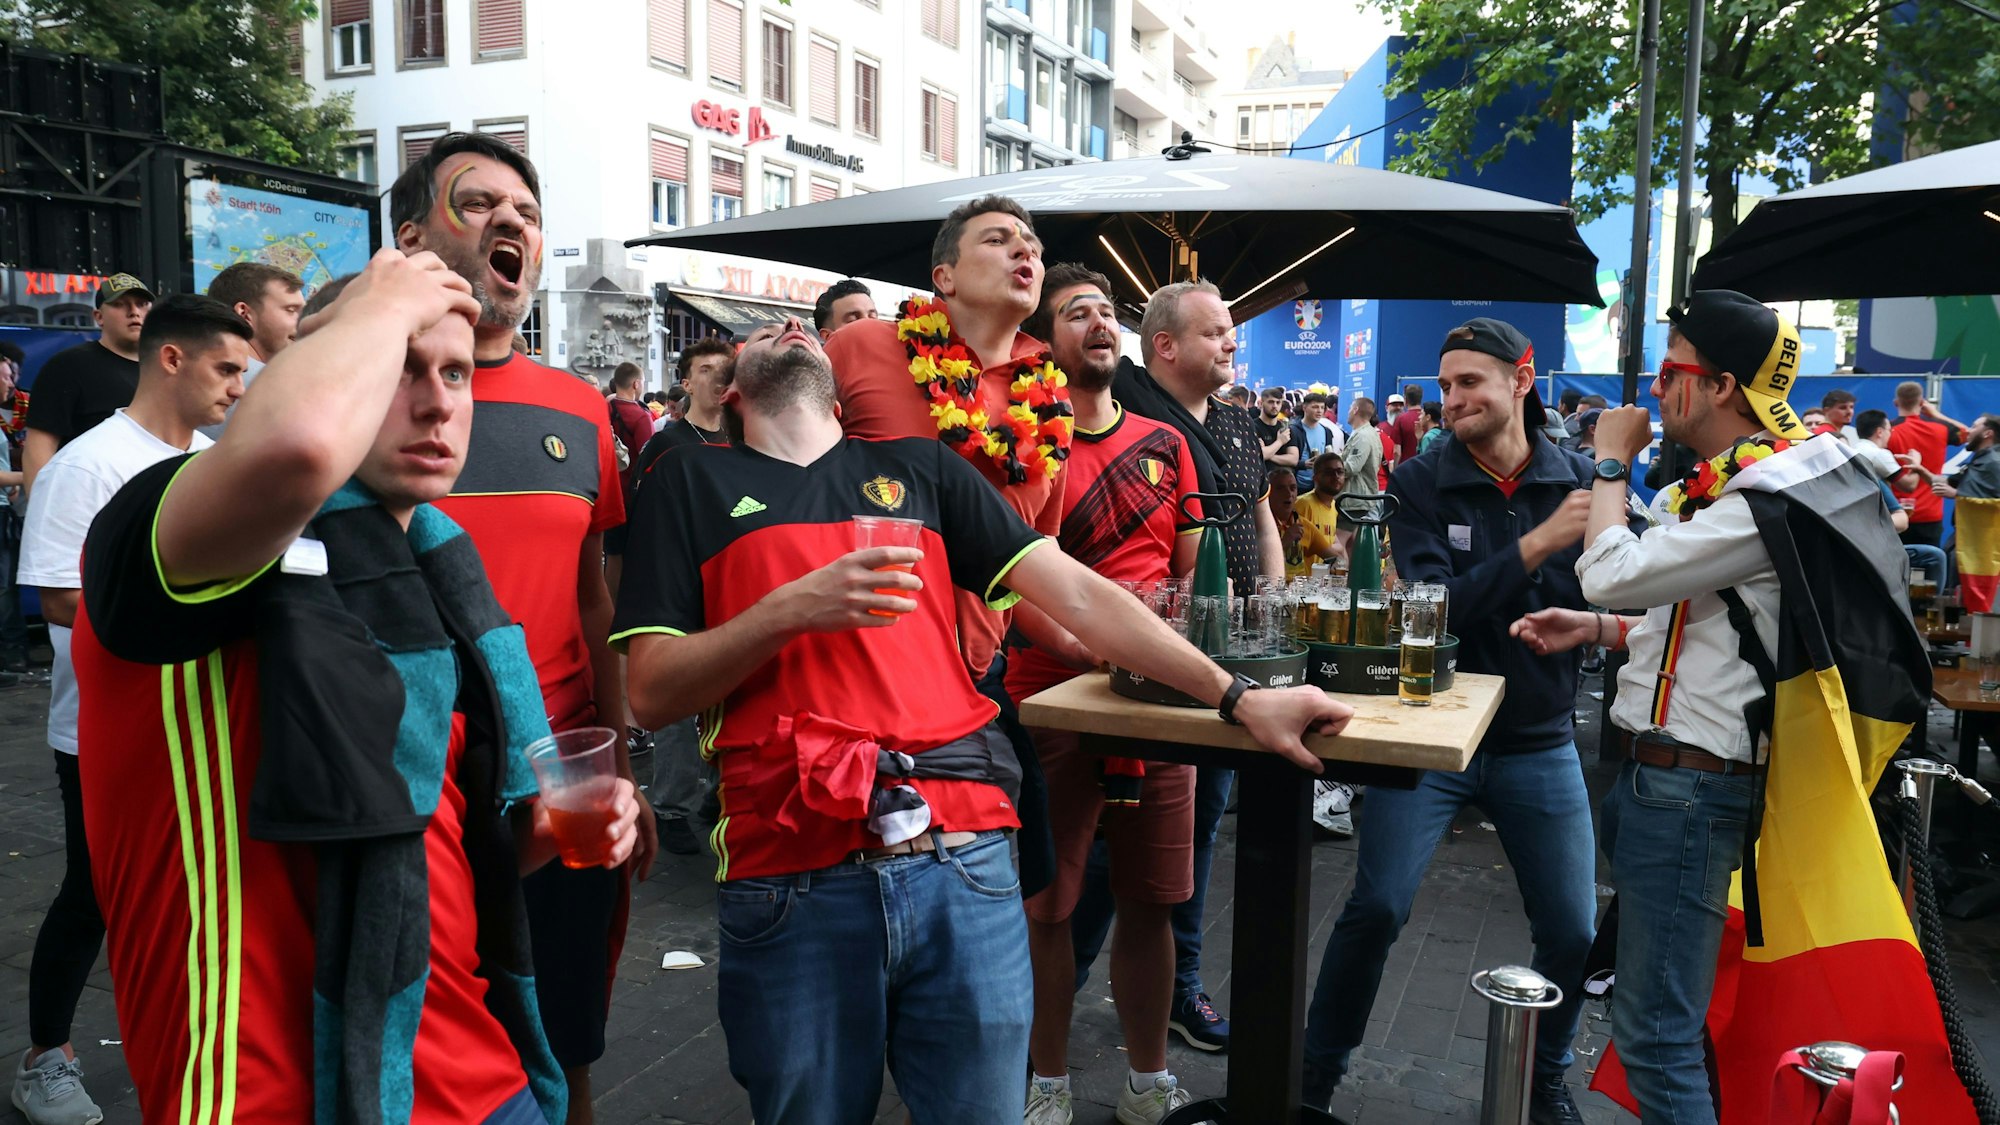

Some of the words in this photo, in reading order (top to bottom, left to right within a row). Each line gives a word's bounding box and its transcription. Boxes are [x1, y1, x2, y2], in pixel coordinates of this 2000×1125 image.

[691, 99, 740, 135] GAG
[785, 134, 847, 168] Immobilien
[847, 154, 864, 173] AG
[263, 178, 307, 195] JCDecaux
[228, 197, 258, 212] Stadt
[258, 203, 282, 215] Köln
[24, 271, 56, 295] XII
[720, 265, 752, 294] XII
[1269, 674, 1293, 686] Gilden
[1366, 664, 1399, 675] Gilden
